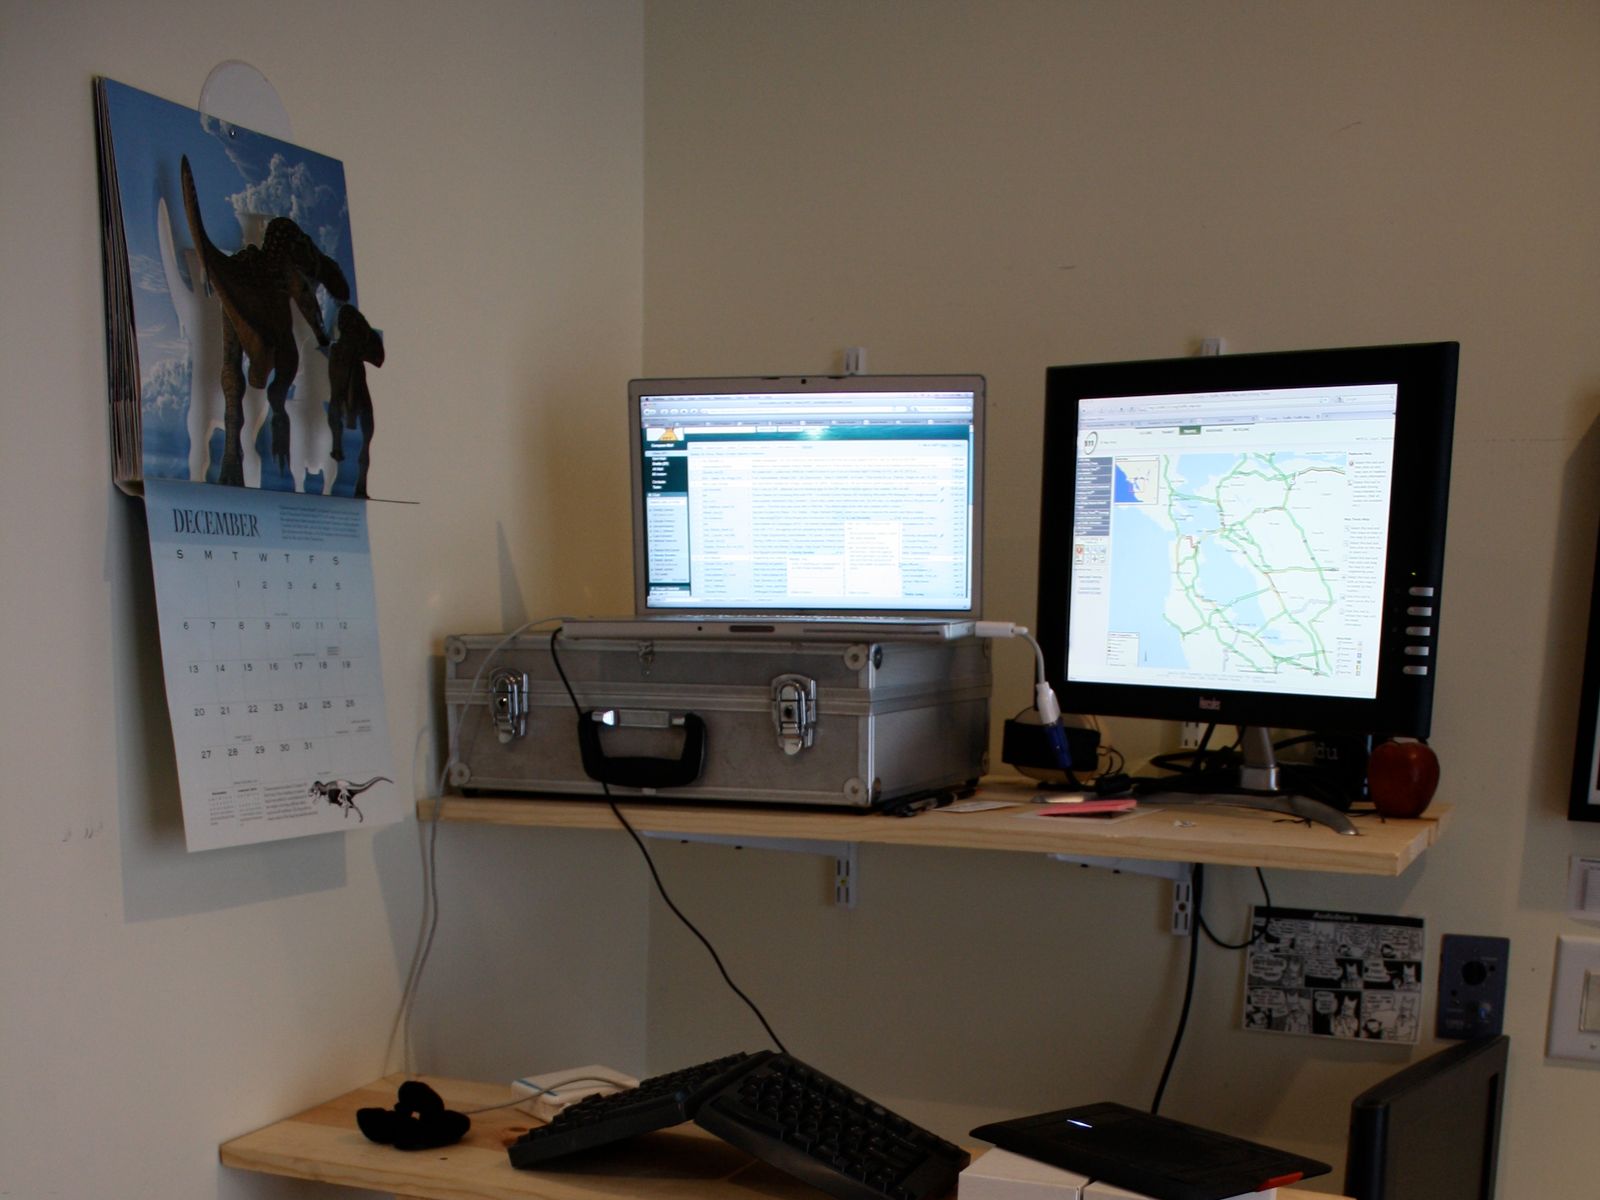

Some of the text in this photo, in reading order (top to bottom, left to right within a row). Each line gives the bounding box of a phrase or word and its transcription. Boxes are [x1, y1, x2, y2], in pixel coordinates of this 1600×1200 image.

[172, 508, 261, 538] DECEMBER
[176, 548, 340, 566] S M T W T F S
[290, 621, 302, 630] 10
[315, 621, 324, 630] 11
[338, 621, 348, 630] 12
[188, 664, 199, 674] 13
[215, 663, 226, 673] 14
[243, 663, 253, 672] 15
[268, 662, 279, 671] 16
[293, 661, 304, 670] 17
[193, 707, 206, 717] 20
[220, 706, 230, 716] 21
[247, 704, 259, 714] 22
[273, 703, 284, 712] 23
[200, 741, 313, 760] 27 28 29 30 31
